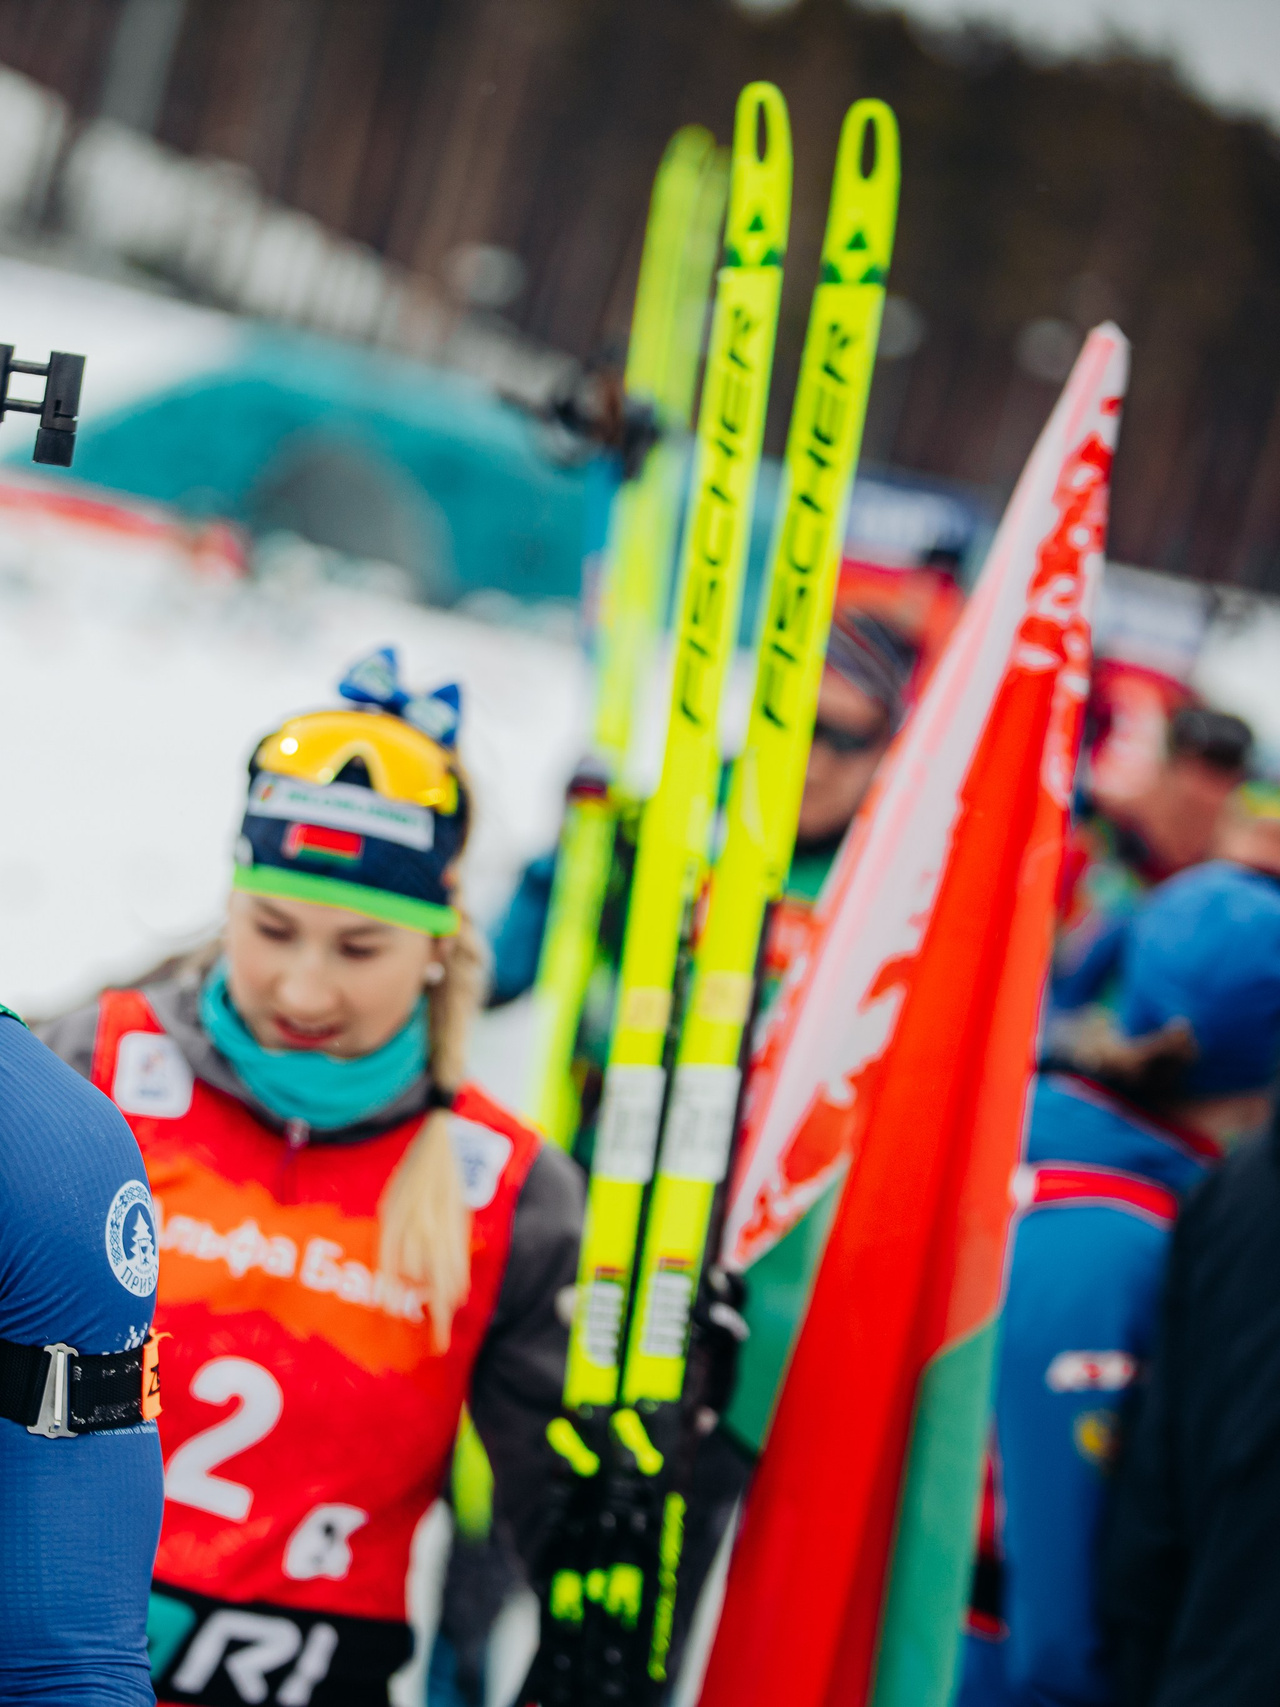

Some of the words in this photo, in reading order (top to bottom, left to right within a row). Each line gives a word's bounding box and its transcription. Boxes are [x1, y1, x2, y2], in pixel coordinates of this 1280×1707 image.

[680, 308, 758, 726] FISCHER
[762, 321, 855, 730] FISCHER
[165, 1357, 282, 1523] 2
